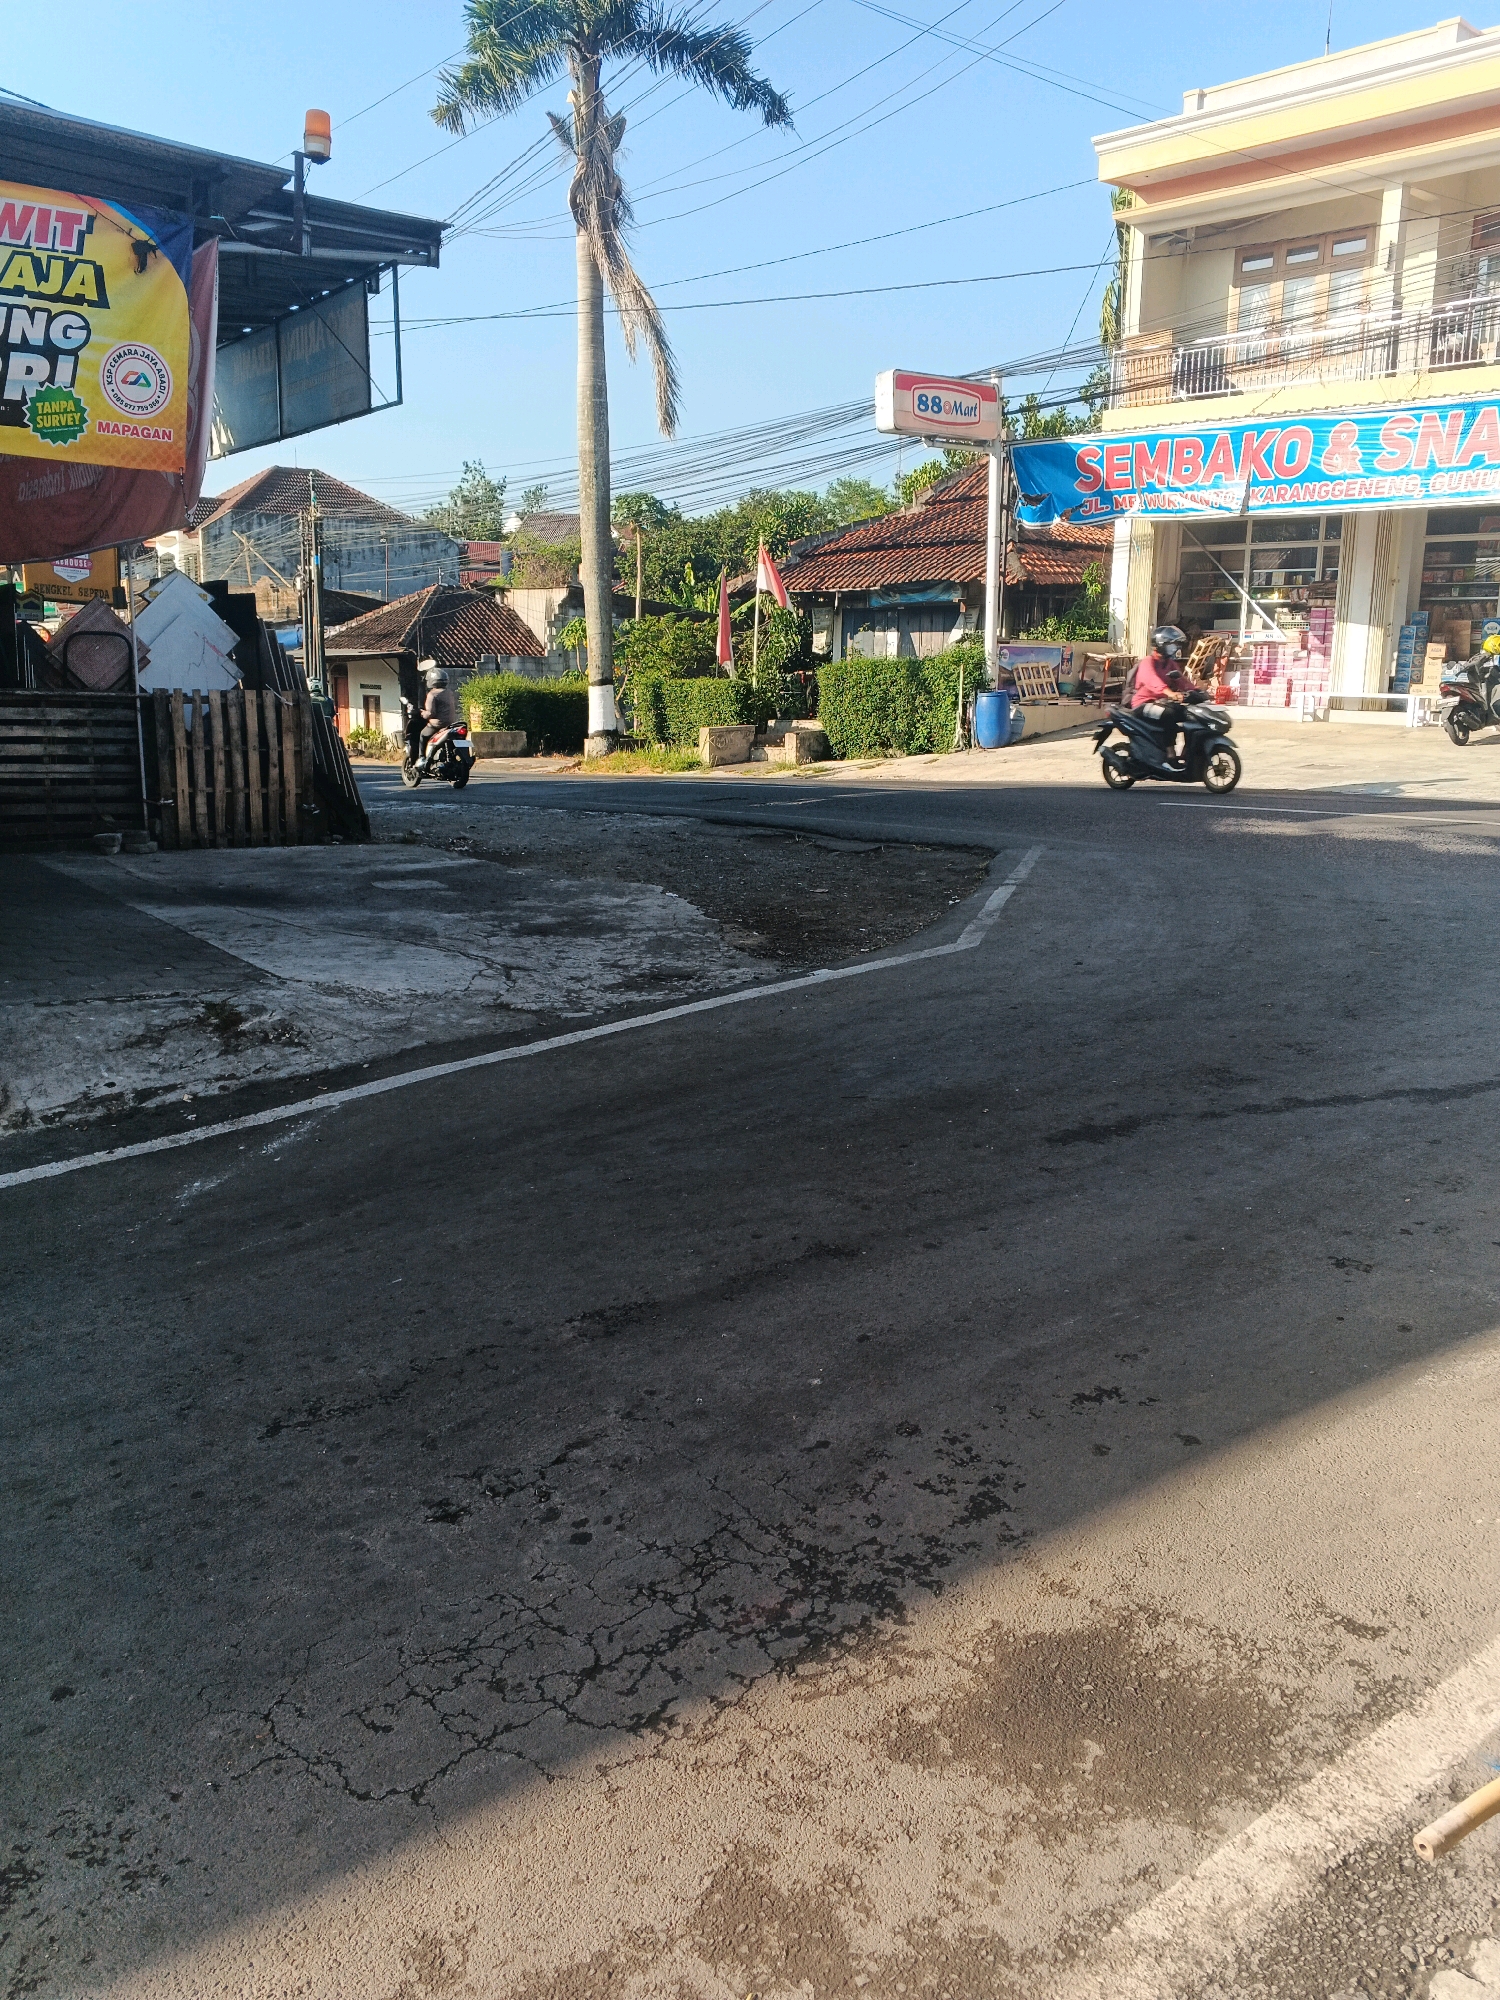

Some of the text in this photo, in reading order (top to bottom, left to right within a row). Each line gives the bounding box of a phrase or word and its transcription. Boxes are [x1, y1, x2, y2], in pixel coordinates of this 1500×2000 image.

[0, 253, 101, 302] AJA
[0, 351, 76, 400] RI
[109, 348, 139, 368] CEMARA
[139, 350, 159, 369] JAYA
[156, 368, 166, 395] ABADI
[36, 400, 76, 415] TANPA
[36, 412, 81, 428] SURVEY
[917, 393, 978, 417] 88 Mart
[97, 421, 173, 441] MAPAGAN
[1074, 405, 1500, 493] SEMBAKO & SNA
[1080, 498, 1110, 516] JL.
[1430, 467, 1500, 494] GUNU
[33, 583, 110, 599] BENGKEL SEPEDA
